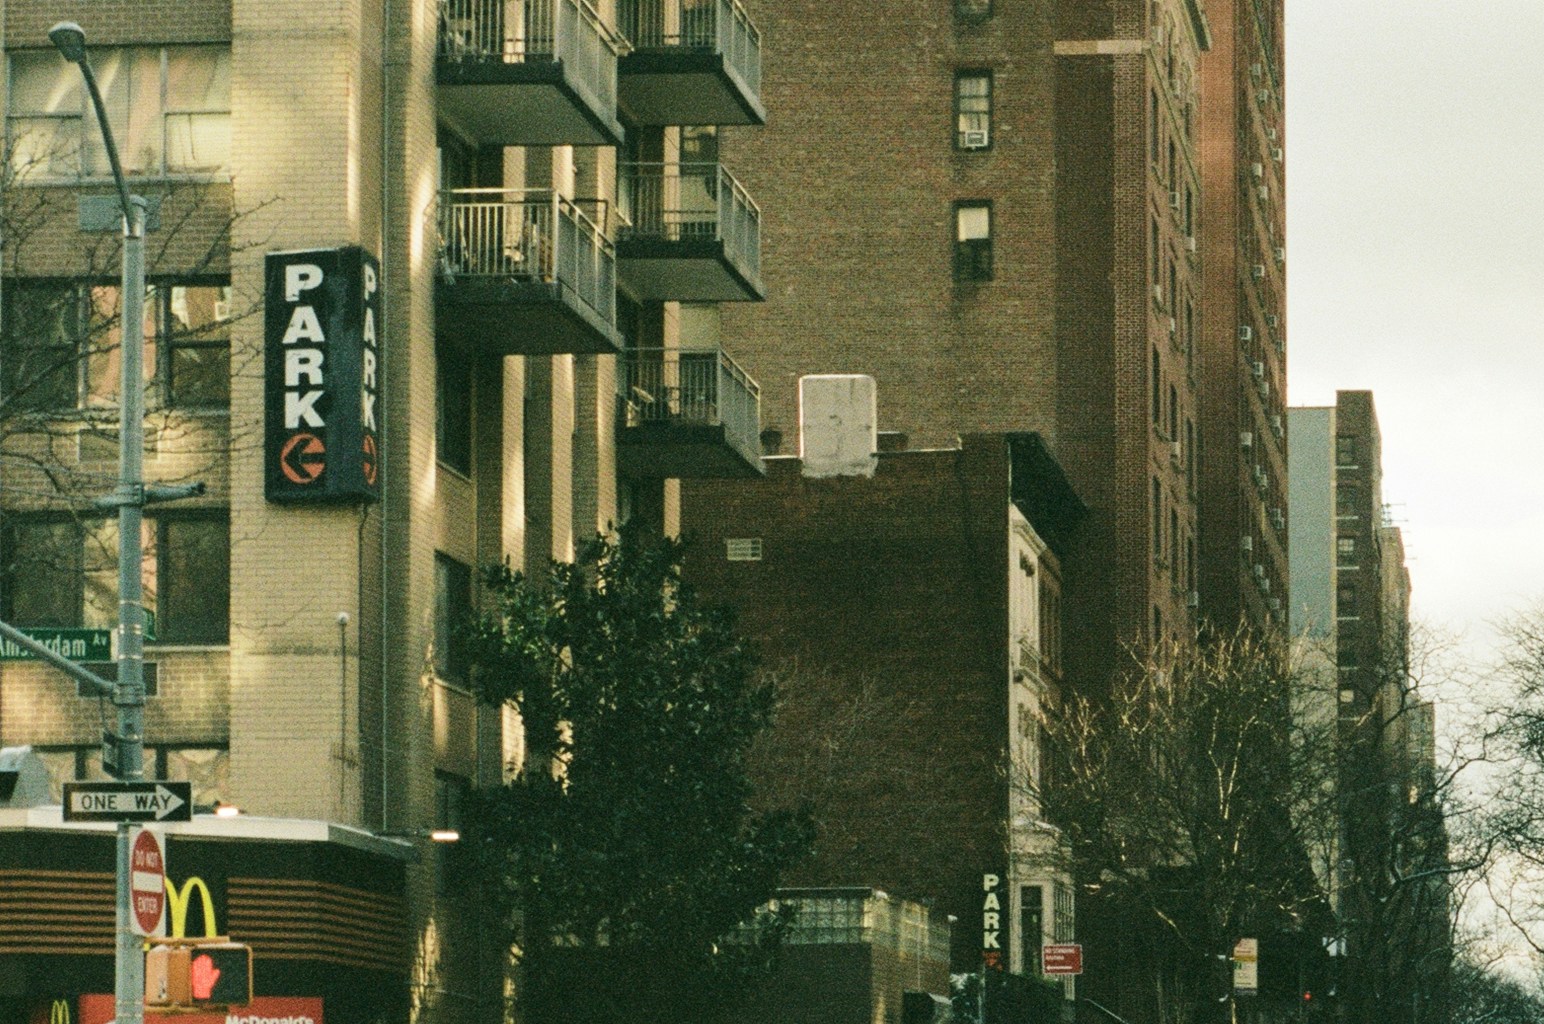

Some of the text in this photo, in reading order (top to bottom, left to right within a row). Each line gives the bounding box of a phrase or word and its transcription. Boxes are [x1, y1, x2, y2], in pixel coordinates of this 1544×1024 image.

[282, 263, 325, 429] PARK
[363, 264, 377, 432] PARK
[81, 793, 172, 811] ONE WAY
[983, 873, 1000, 949] PARK
